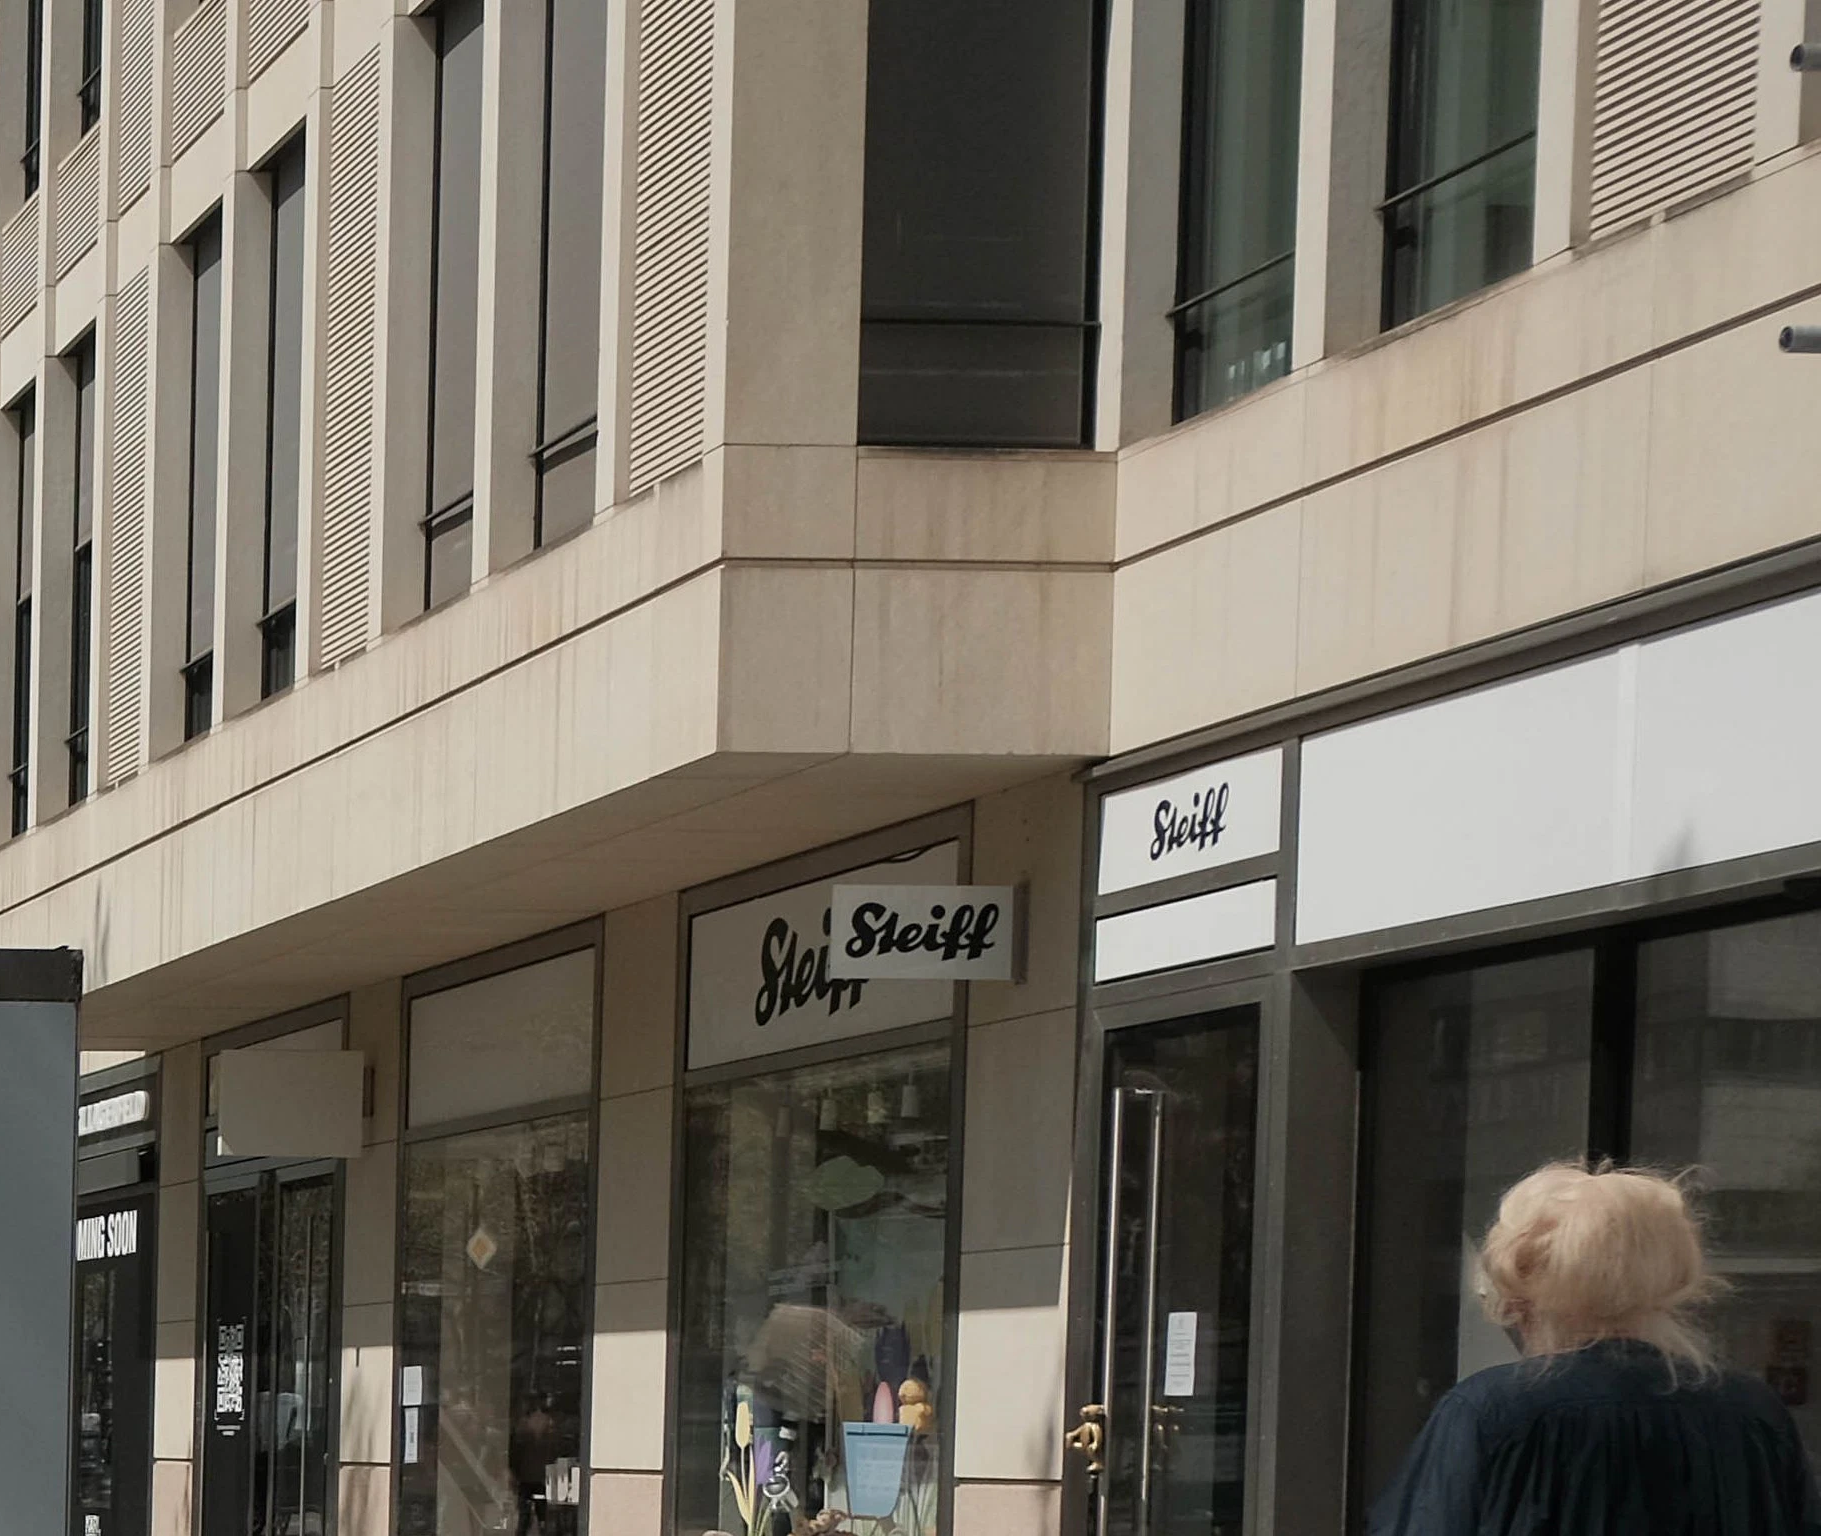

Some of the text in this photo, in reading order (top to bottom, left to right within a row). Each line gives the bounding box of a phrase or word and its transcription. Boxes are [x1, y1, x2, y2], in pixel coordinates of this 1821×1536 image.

[1150, 782, 1230, 861] Steiff
[844, 901, 1001, 961] Steiff
[107, 1210, 138, 1258] SOON
